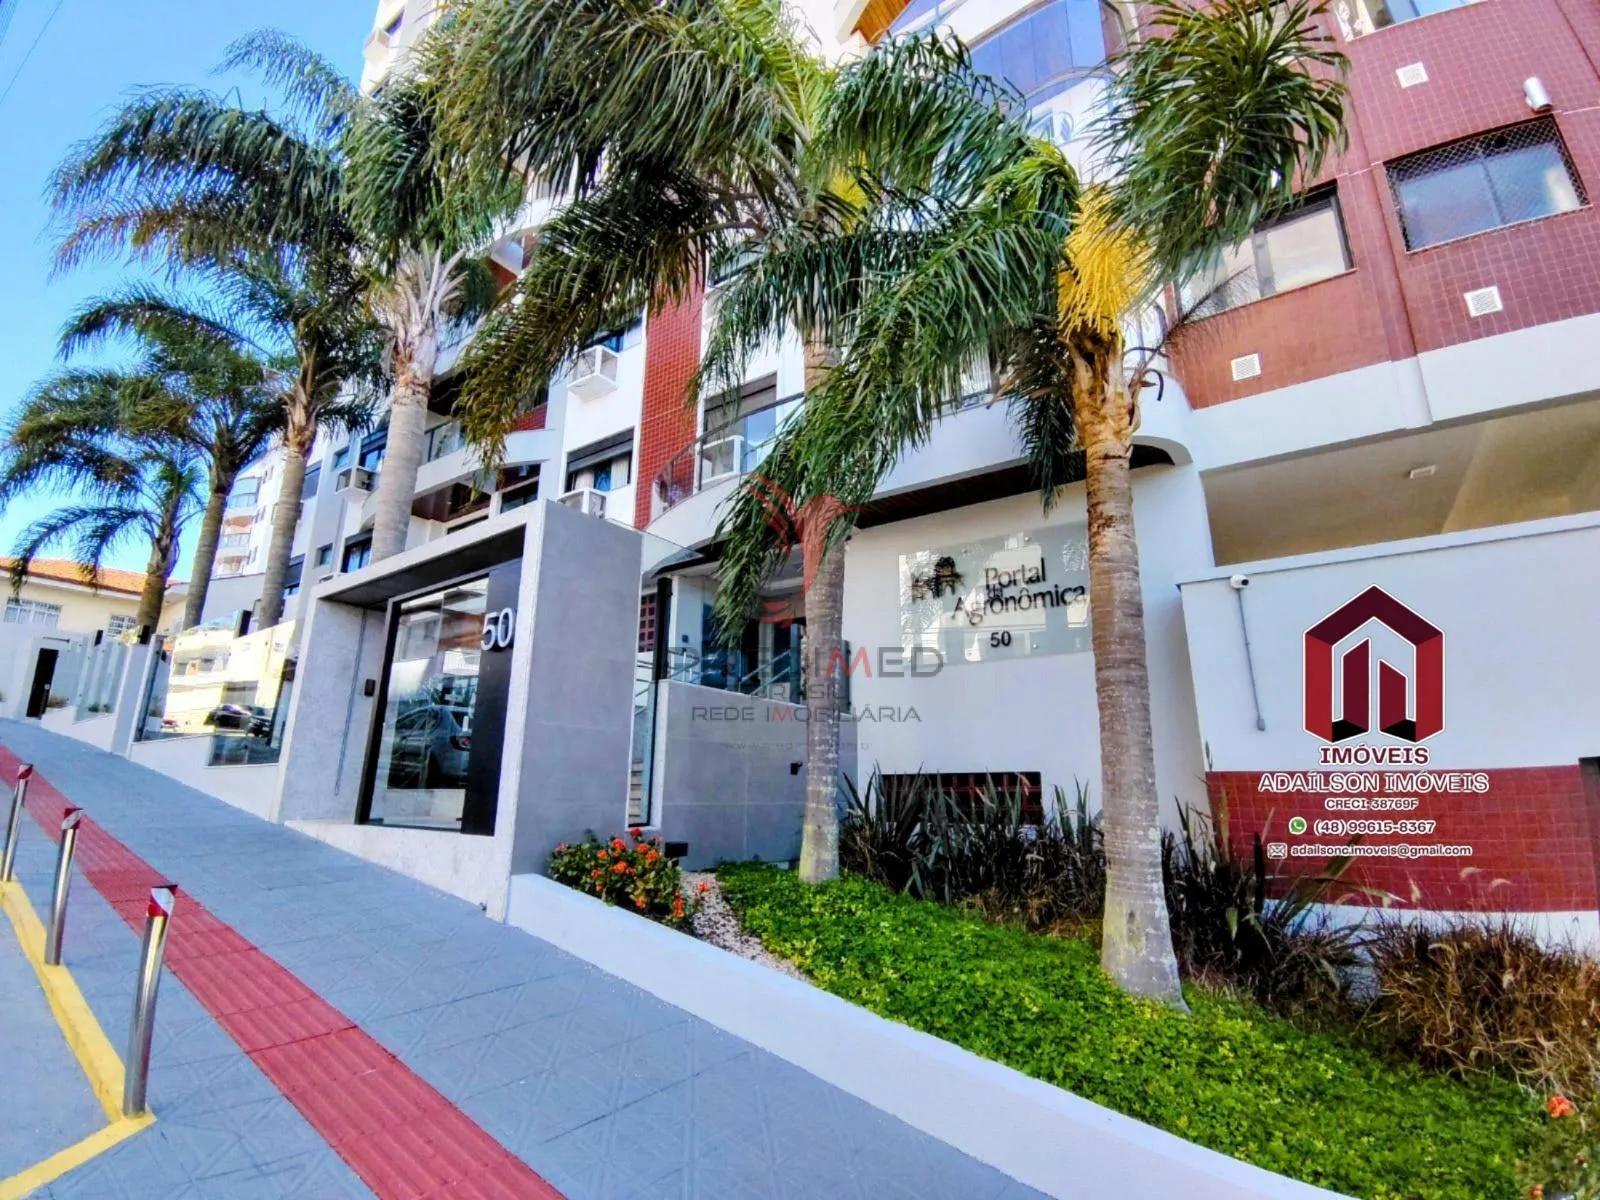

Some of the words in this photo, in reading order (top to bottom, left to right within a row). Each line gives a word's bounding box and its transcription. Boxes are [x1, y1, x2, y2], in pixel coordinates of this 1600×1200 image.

[984, 557, 1047, 589] Portal
[951, 584, 1086, 626] Agronômica
[480, 607, 514, 651] 50
[989, 630, 1012, 648] 50
